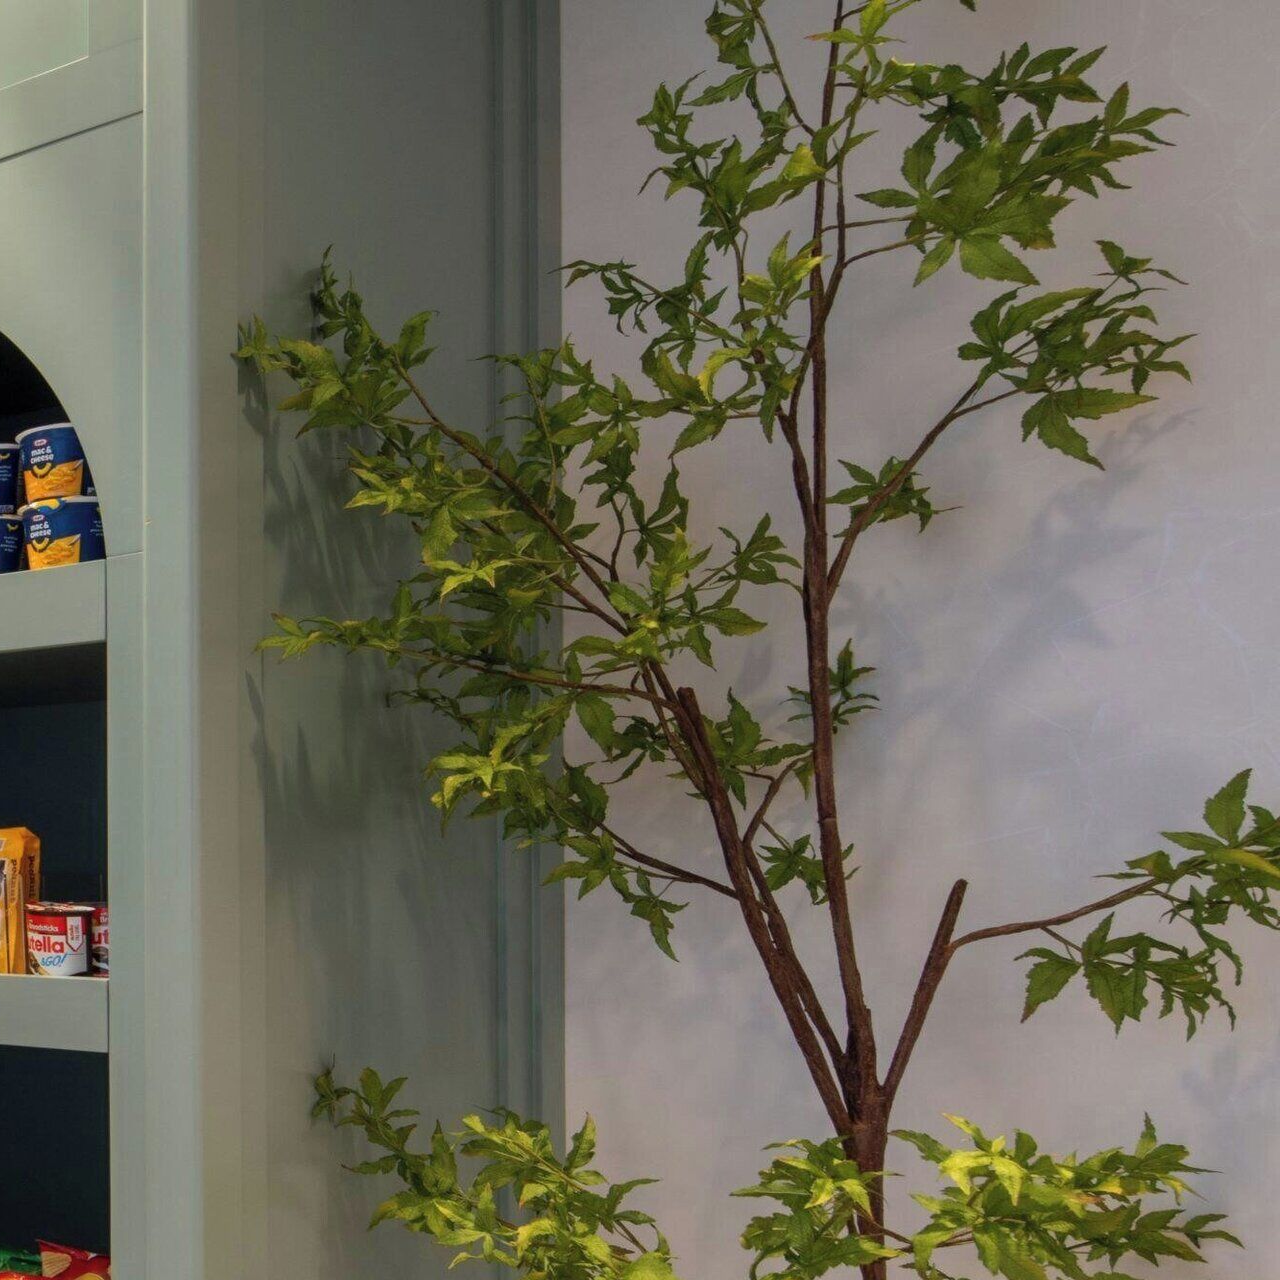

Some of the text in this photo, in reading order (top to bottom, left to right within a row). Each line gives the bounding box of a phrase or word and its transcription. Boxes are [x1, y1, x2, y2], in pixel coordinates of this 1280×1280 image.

[31, 448, 45, 457] mac
[30, 453, 54, 464] cheese
[30, 936, 65, 953] tella
